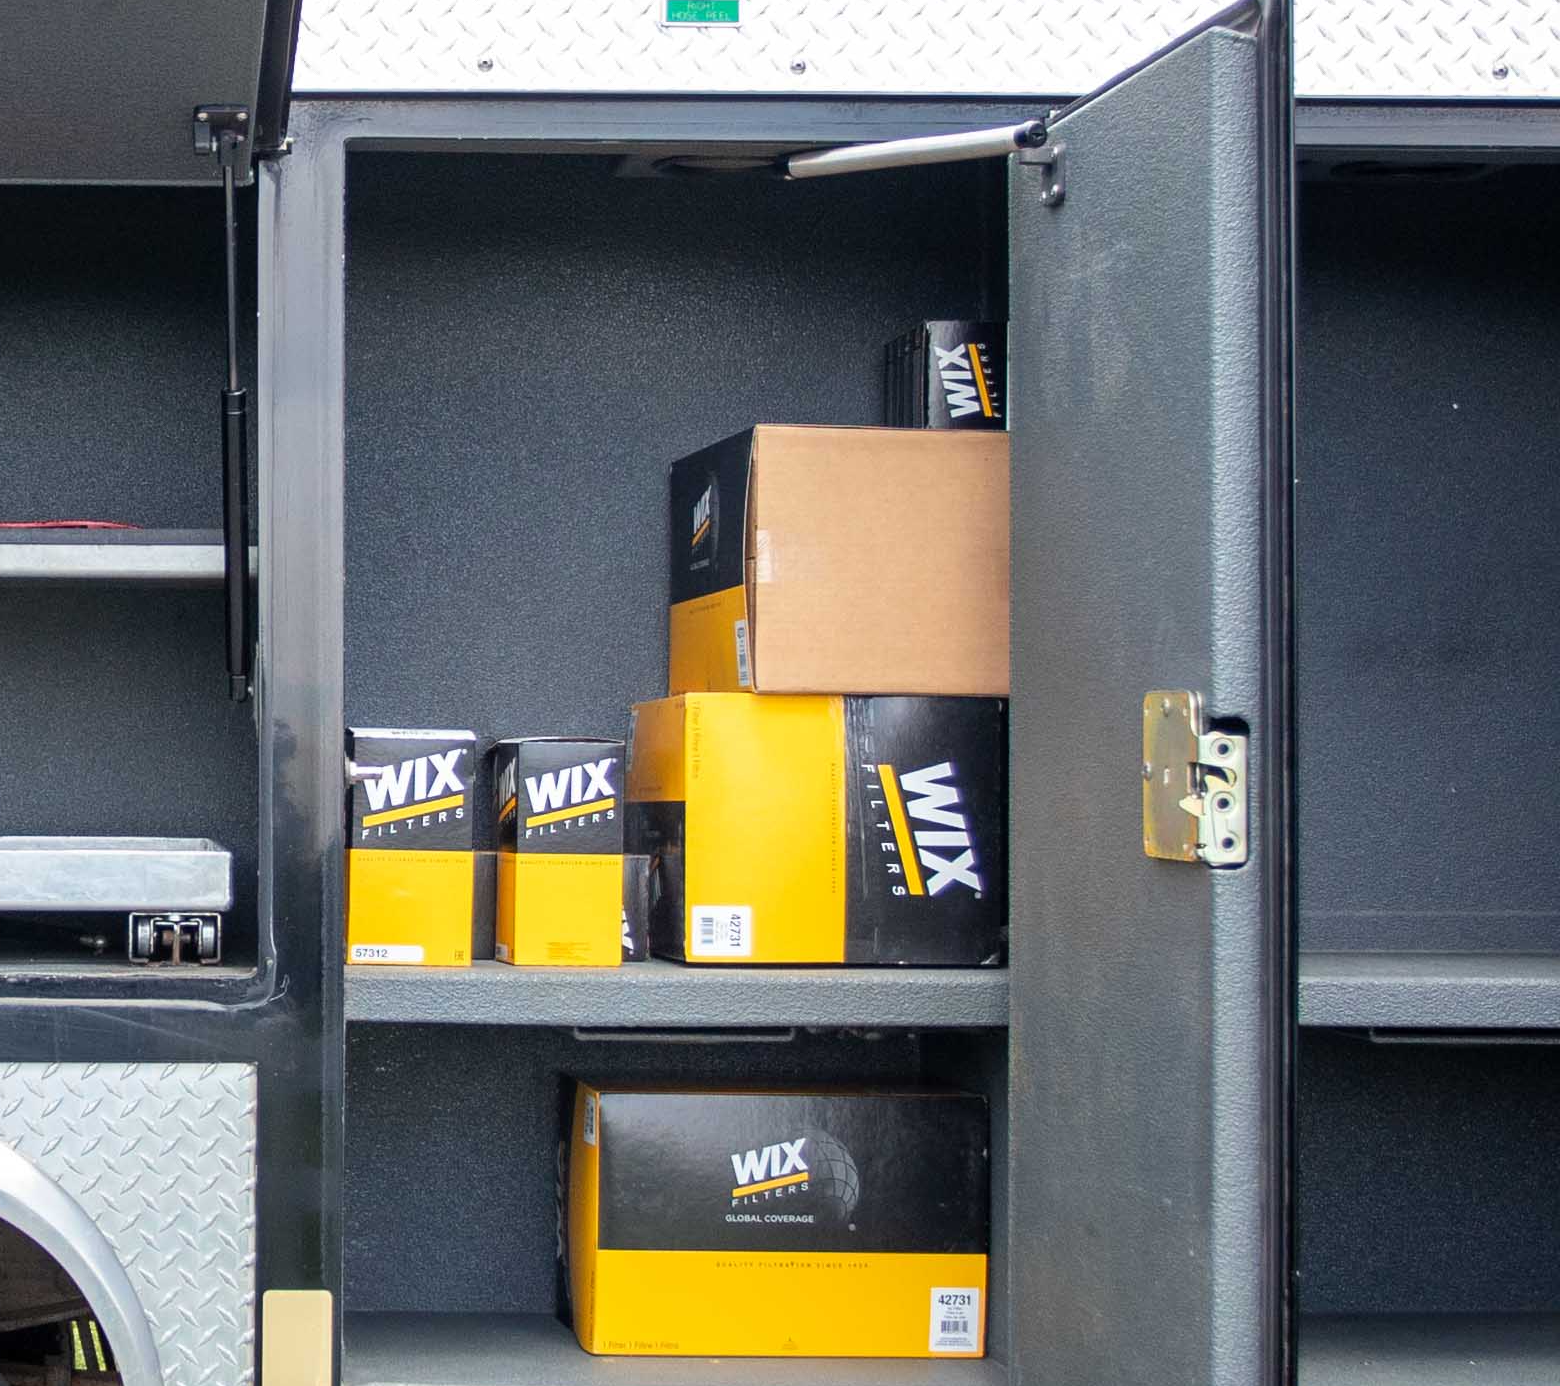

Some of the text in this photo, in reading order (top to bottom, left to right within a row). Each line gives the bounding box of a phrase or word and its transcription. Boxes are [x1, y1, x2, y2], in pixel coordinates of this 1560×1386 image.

[934, 343, 980, 418] WIX
[977, 343, 1002, 418] FILTERS
[693, 485, 712, 533] WIX
[363, 749, 466, 811] WIX
[525, 758, 616, 813] WIX
[362, 808, 464, 840] FILTERS
[525, 810, 615, 839] FILTERS
[861, 764, 906, 896] FILTERS
[899, 762, 983, 897] WIX
[355, 948, 388, 958] 57312
[730, 914, 742, 947] 42731
[731, 1138, 809, 1186] WIX
[725, 1215, 814, 1223] GLOBAL COVERAGE
[731, 1182, 809, 1208] FILTERS
[938, 1294, 971, 1306] 42731
